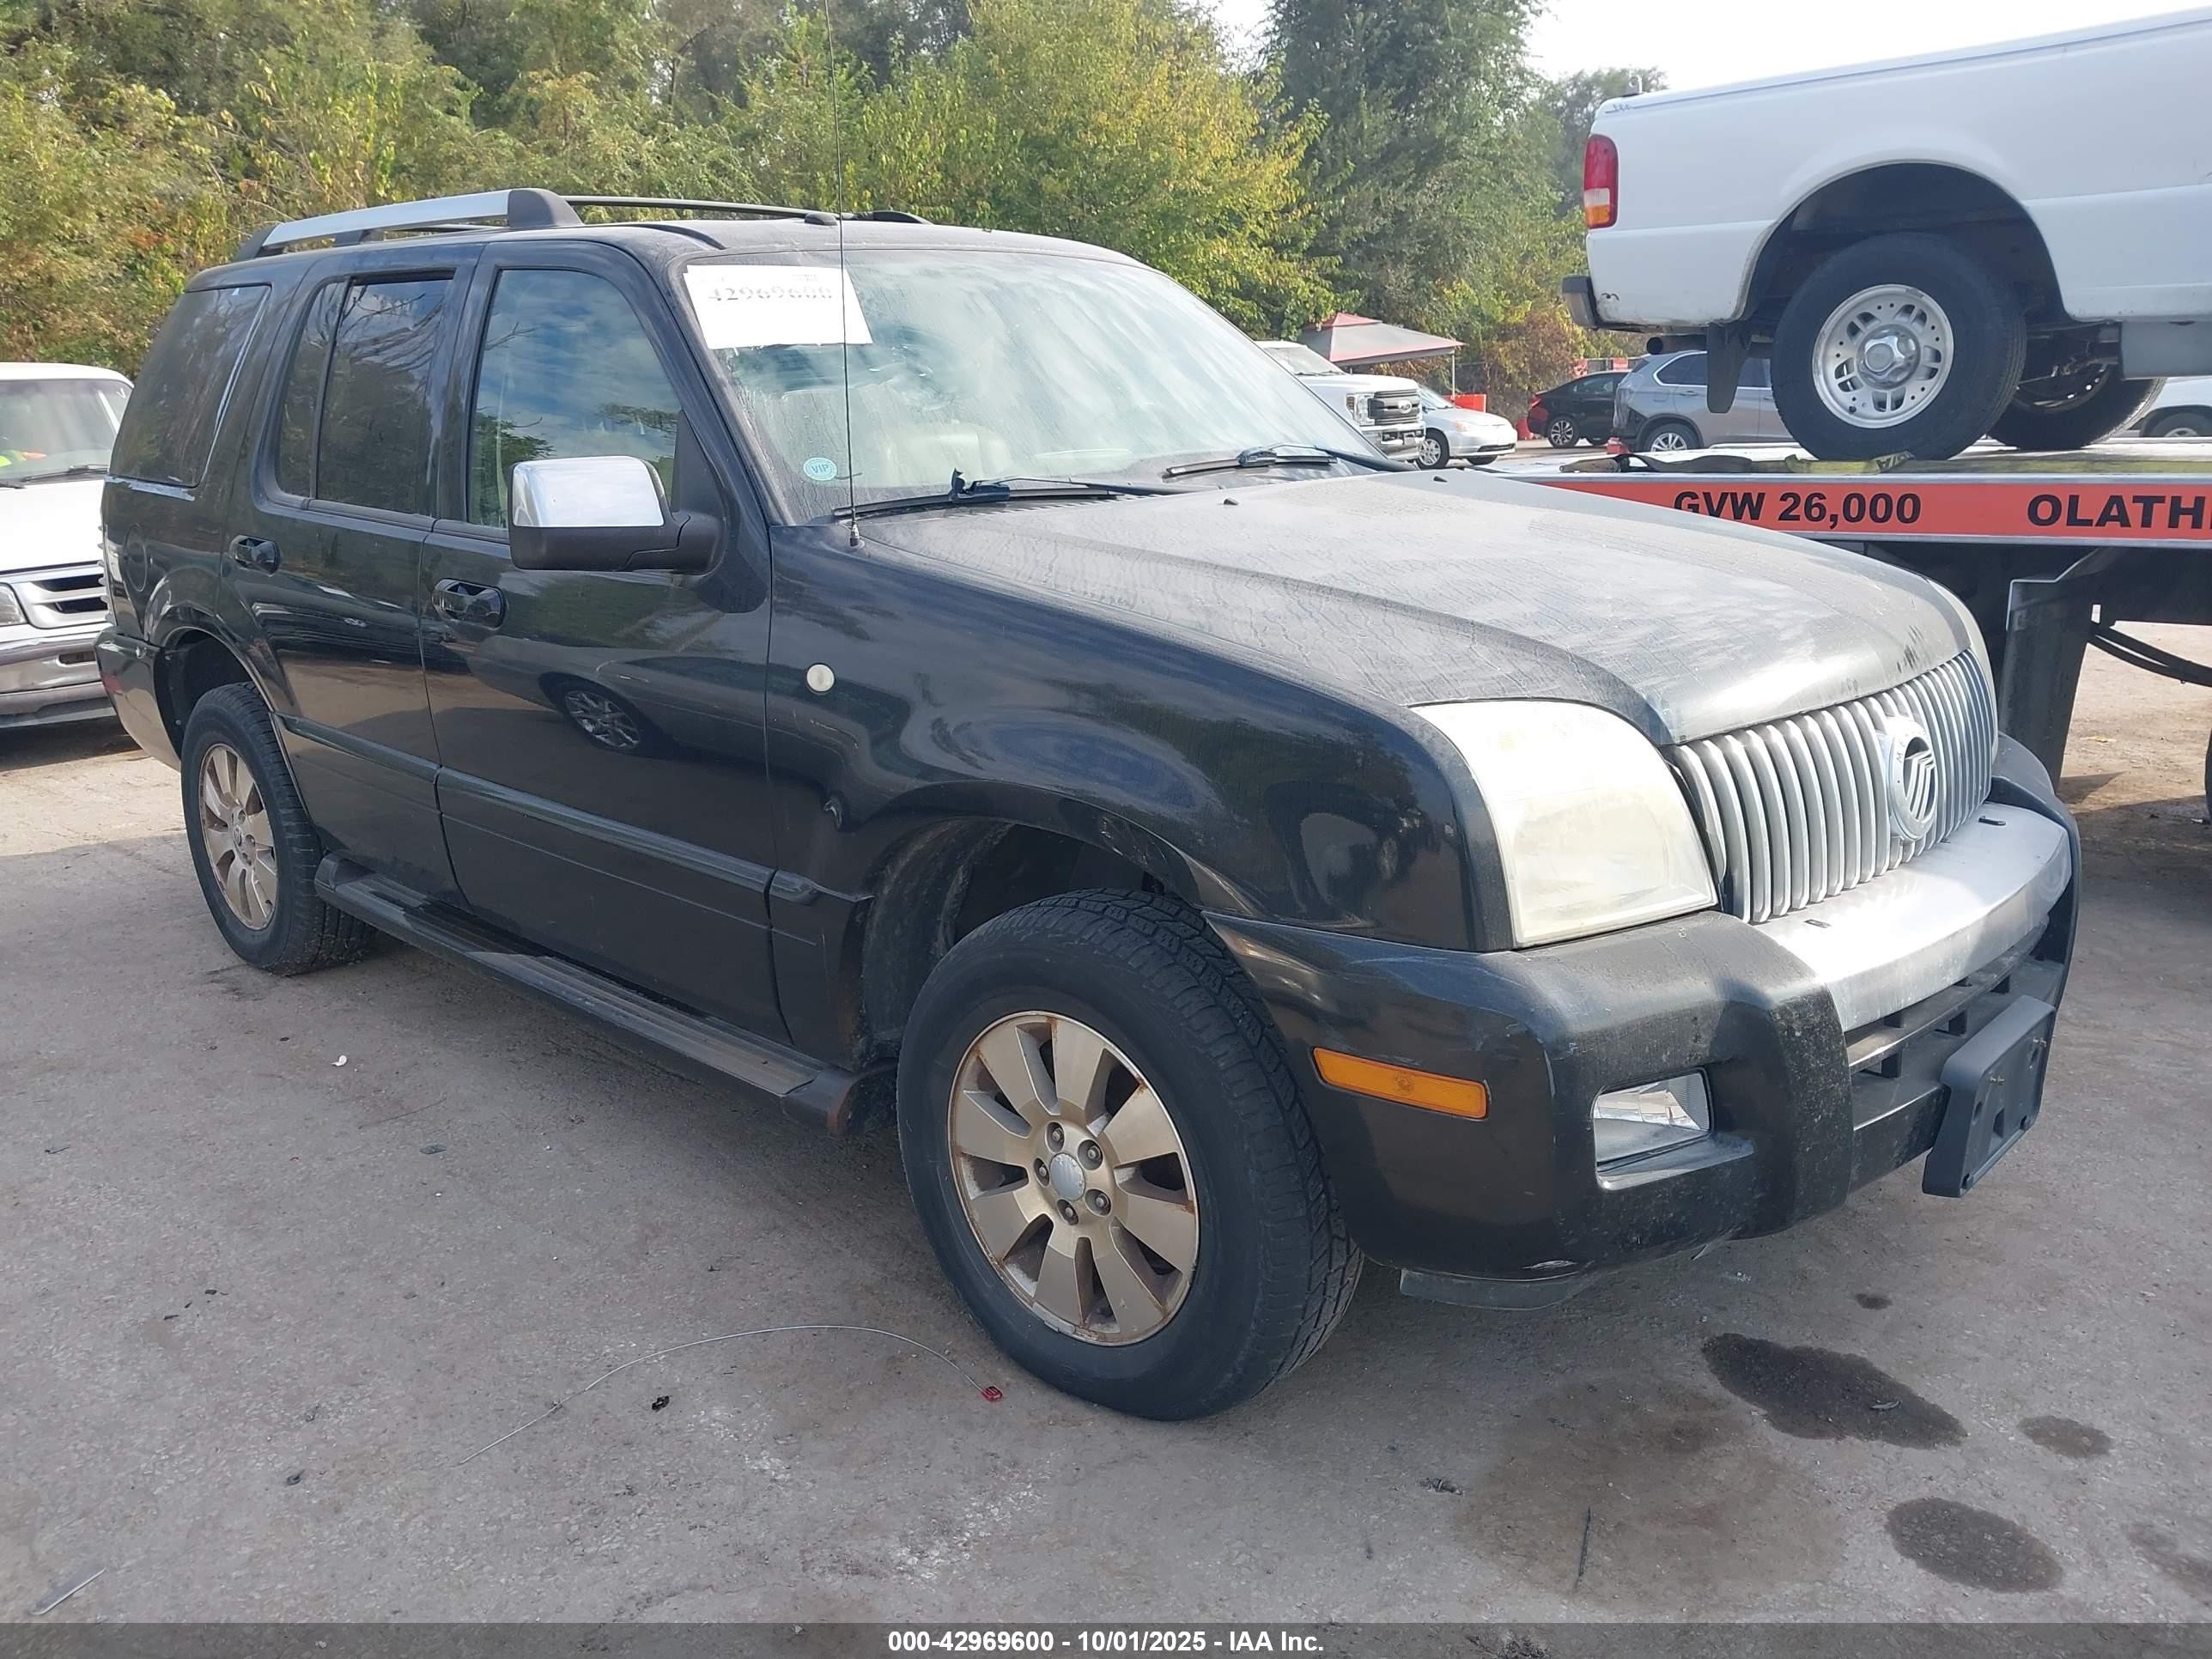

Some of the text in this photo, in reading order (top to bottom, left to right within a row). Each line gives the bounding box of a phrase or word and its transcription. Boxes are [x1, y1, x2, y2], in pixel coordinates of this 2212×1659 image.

[811, 464, 830, 474] VIP
[1674, 491, 1922, 530] GVW 26,000
[2027, 494, 2212, 529] OLATH
